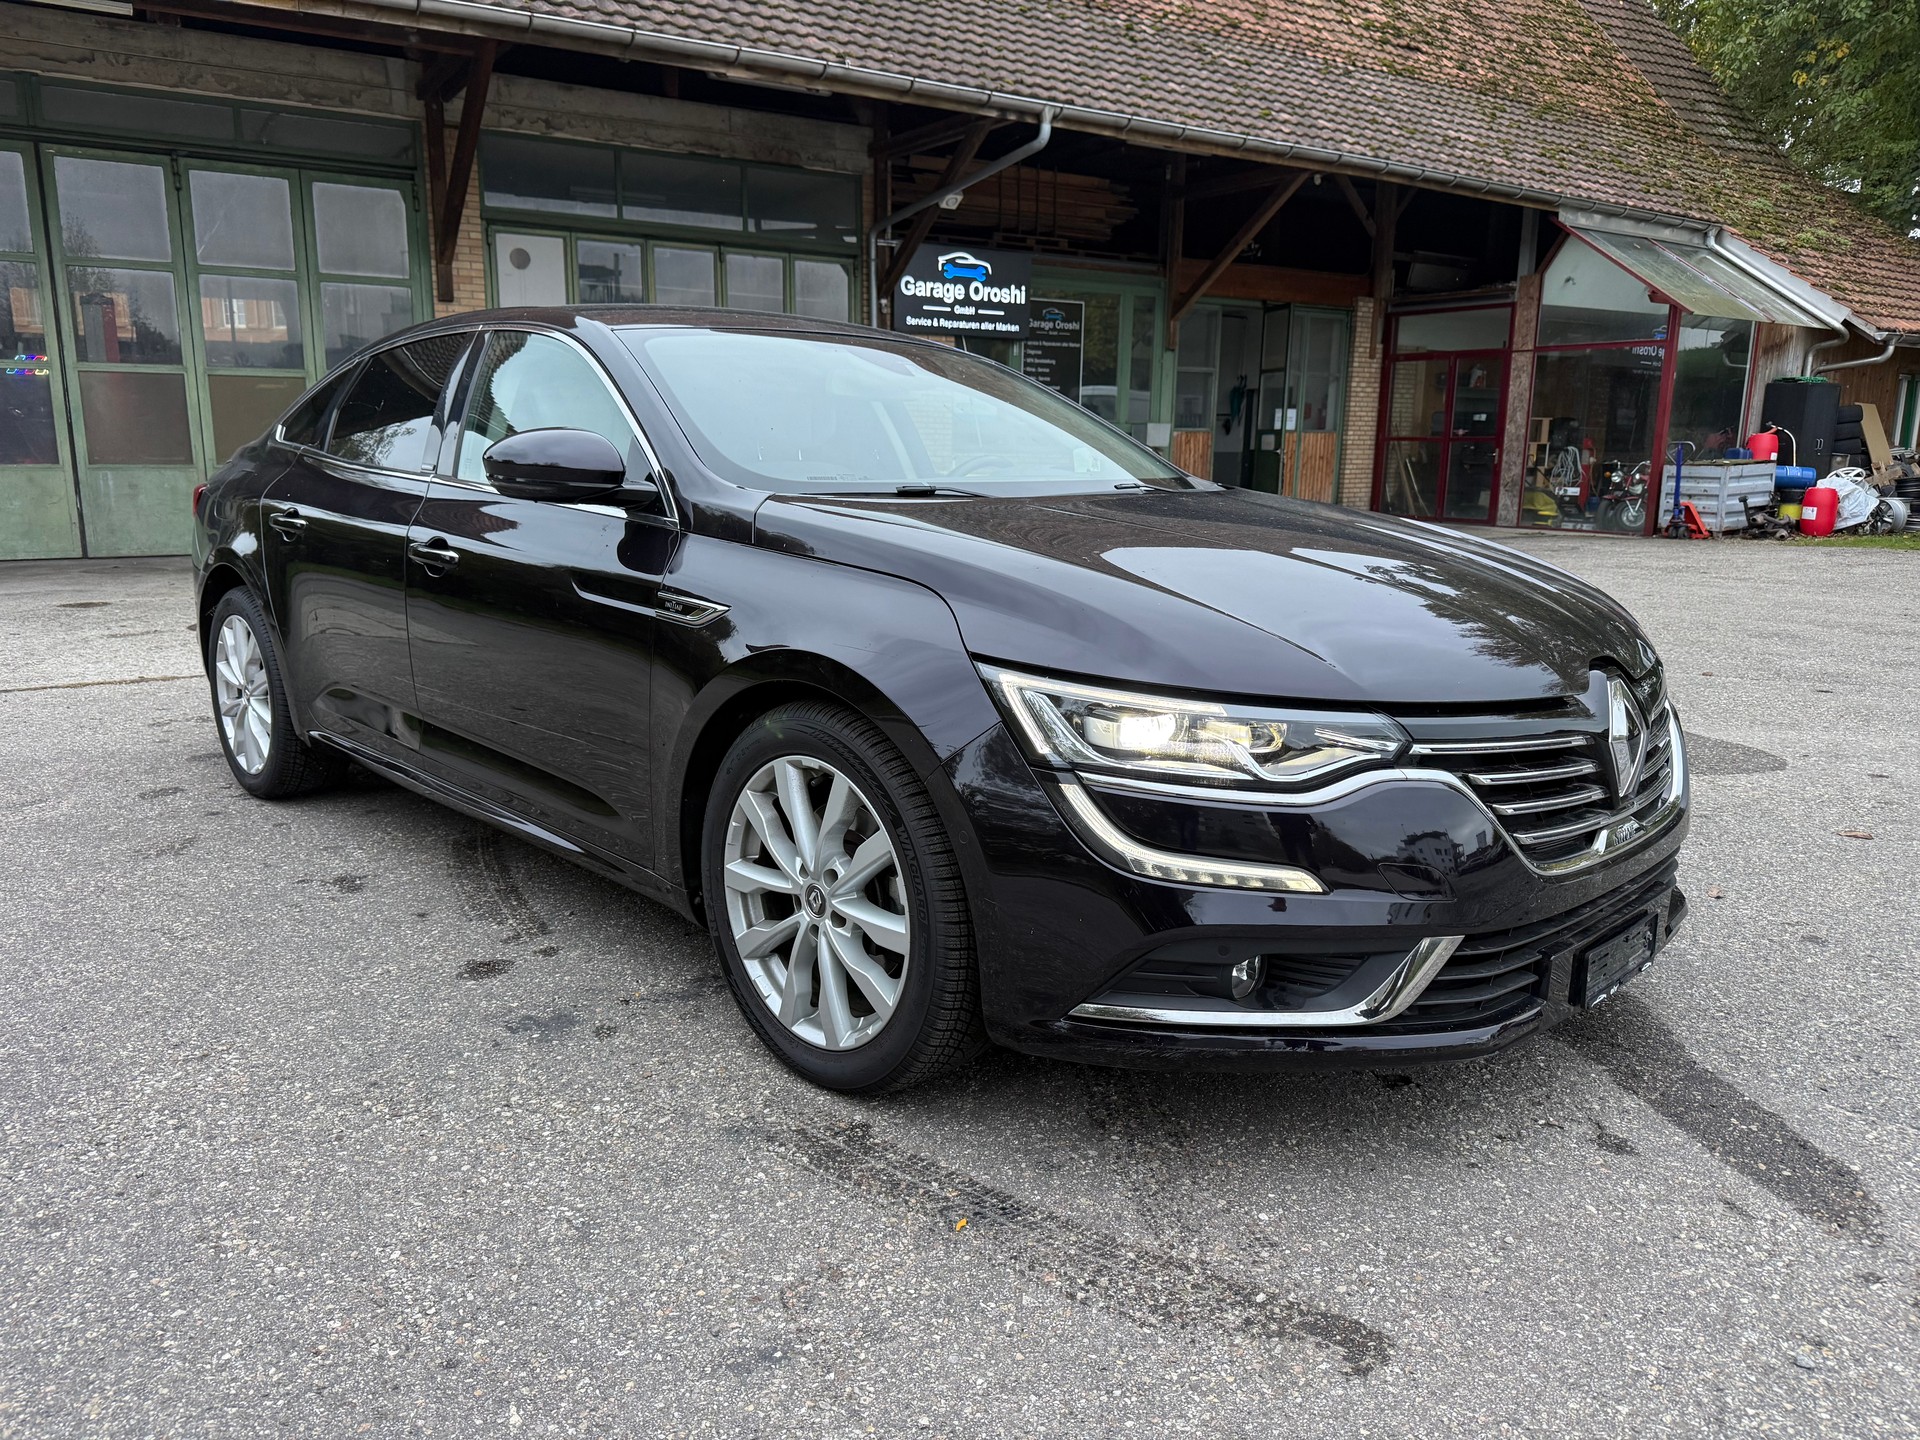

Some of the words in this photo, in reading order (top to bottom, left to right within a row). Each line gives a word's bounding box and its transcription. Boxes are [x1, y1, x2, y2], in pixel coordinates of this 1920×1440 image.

[900, 275, 965, 303] Garage
[969, 281, 1026, 304] Oroshi
[953, 305, 976, 315] GmbH
[906, 316, 932, 327] Service
[933, 318, 938, 327] &
[939, 318, 980, 330] Reparaturen
[980, 321, 995, 330] aller
[996, 322, 1020, 332] Marken
[1055, 320, 1080, 330] Oroshi
